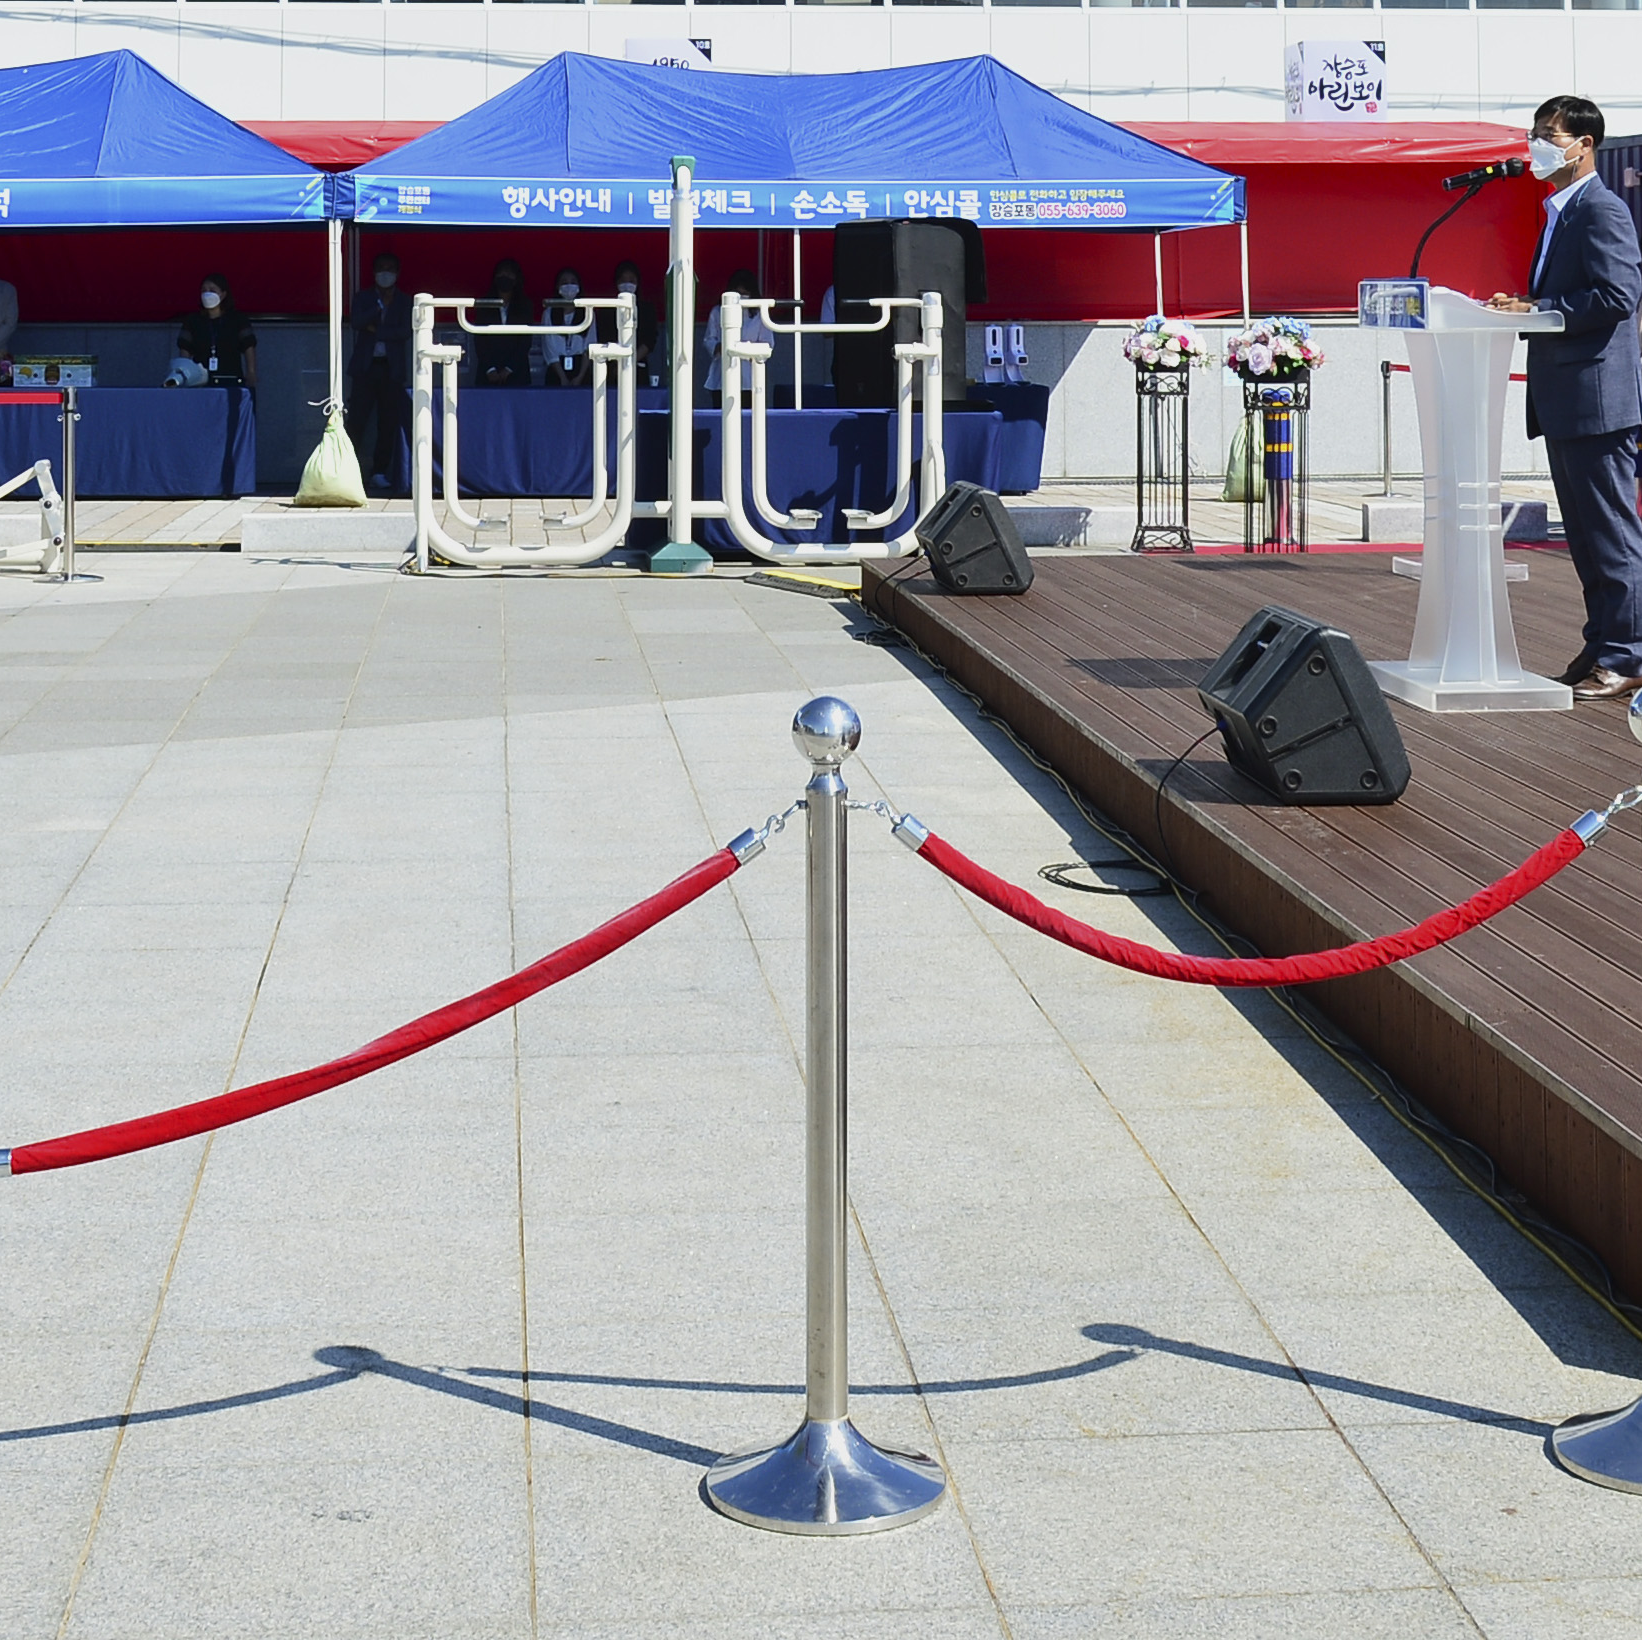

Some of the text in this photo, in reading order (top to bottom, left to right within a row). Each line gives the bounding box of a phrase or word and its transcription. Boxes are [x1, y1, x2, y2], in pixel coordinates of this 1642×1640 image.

[501, 186, 612, 219] 행사안내
[789, 189, 870, 220] 손소독
[903, 189, 983, 219] 안심콜
[990, 202, 1126, 219] 장승포동 055-639-3060
